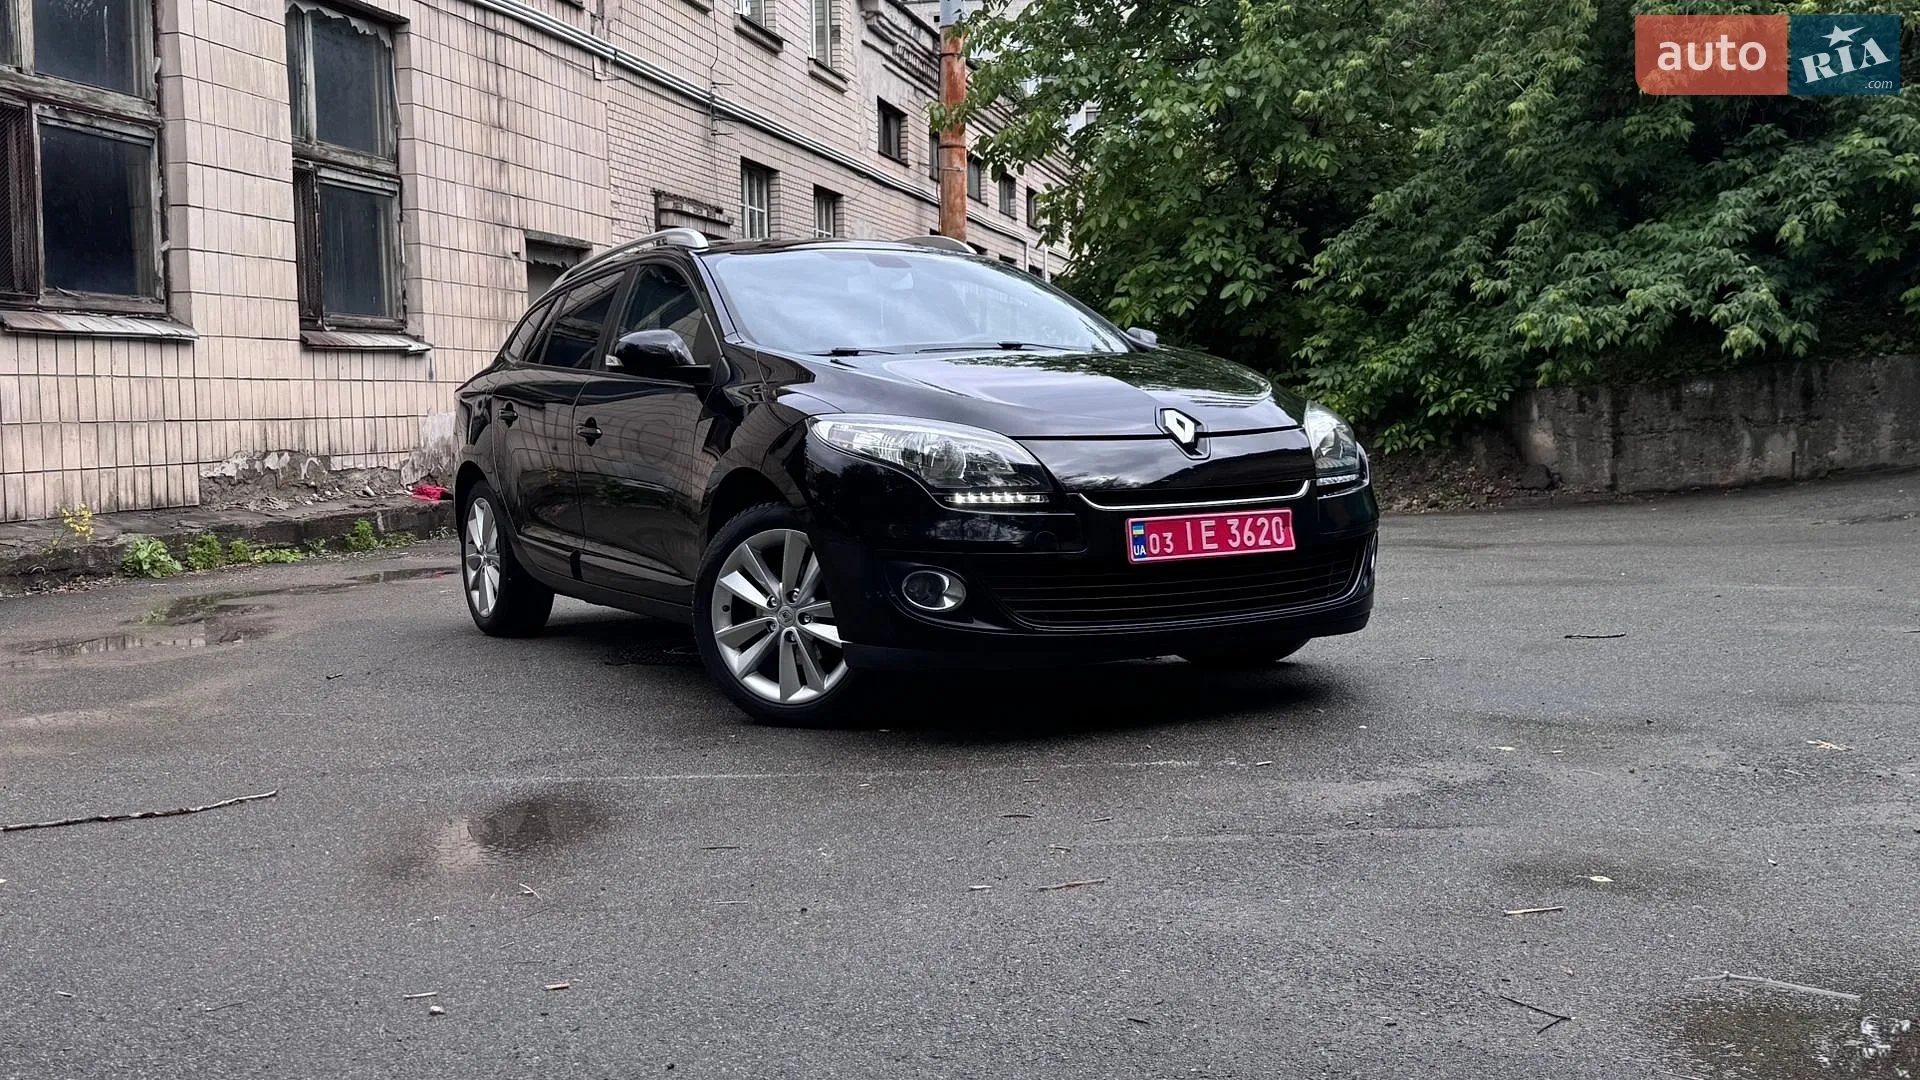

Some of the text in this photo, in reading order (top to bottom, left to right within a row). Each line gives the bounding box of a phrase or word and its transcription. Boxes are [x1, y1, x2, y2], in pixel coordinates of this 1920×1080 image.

[1149, 516, 1286, 554] 03 IE 3620
[1133, 545, 1147, 556] UA
